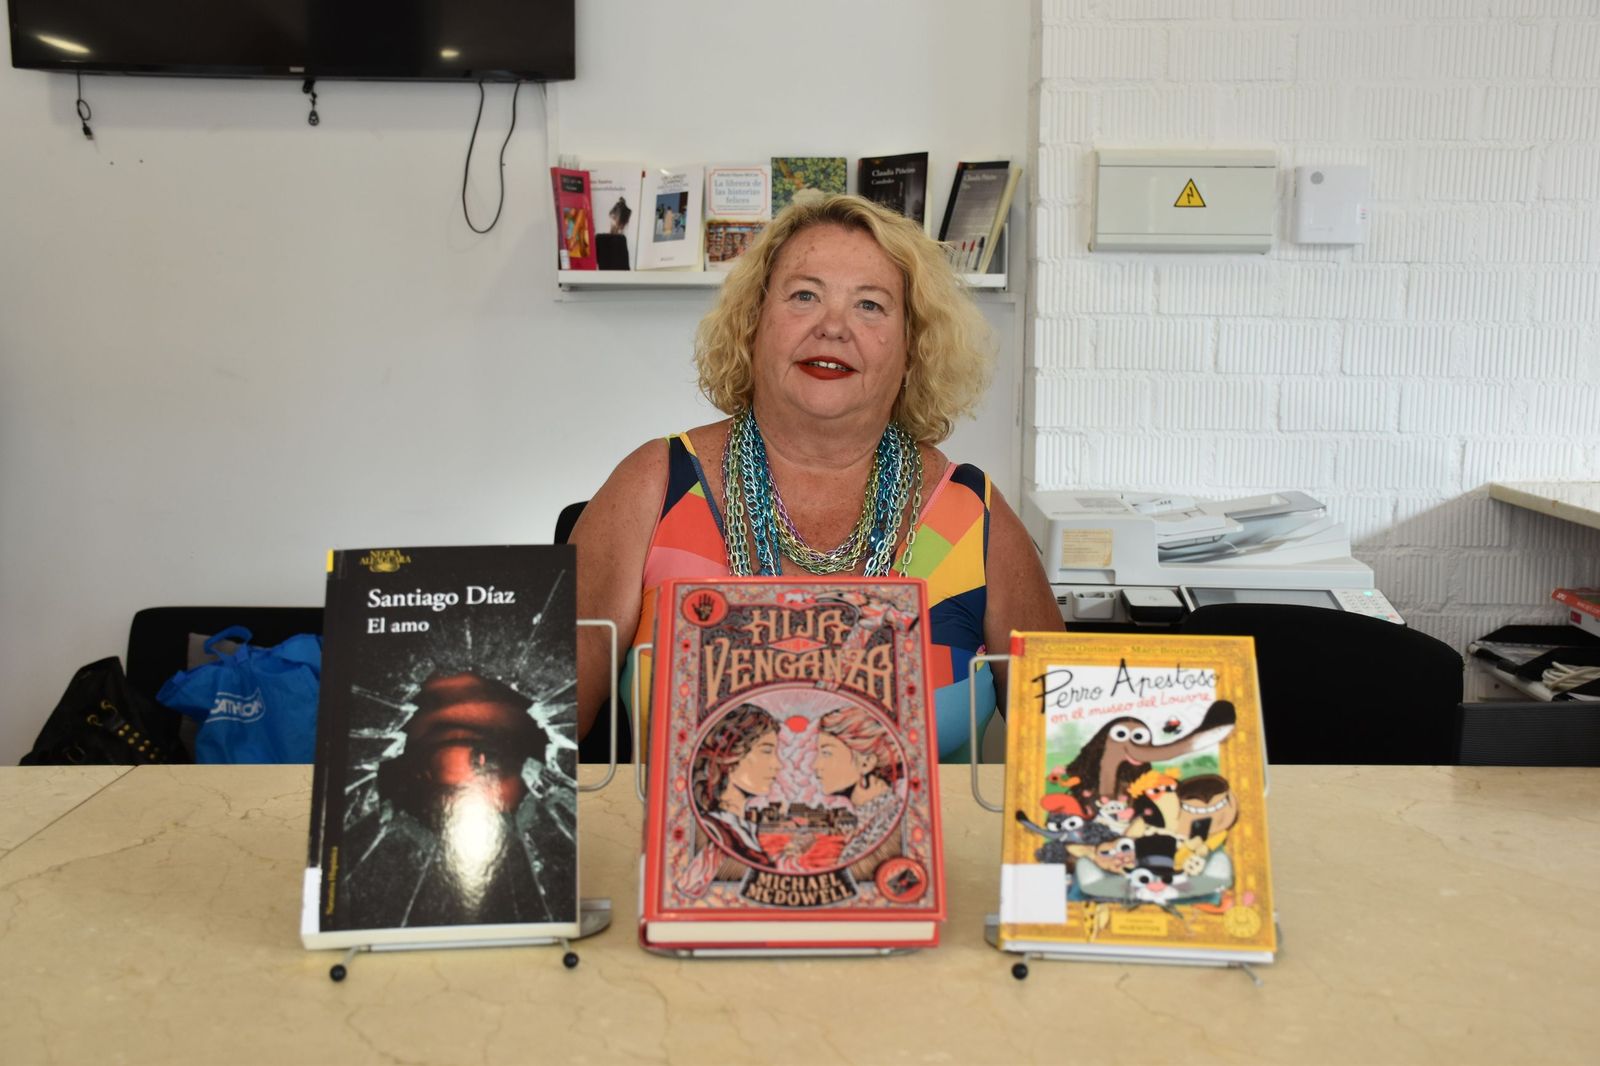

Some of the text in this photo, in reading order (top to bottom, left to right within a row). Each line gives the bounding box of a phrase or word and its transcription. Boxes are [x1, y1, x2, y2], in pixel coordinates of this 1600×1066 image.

[871, 168, 894, 177] Claudia
[369, 549, 401, 560] NEGRA
[367, 585, 516, 611] Santiago Díaz
[367, 617, 430, 634] El amo
[742, 608, 851, 645] HIJA
[703, 637, 894, 711] VENGANZA
[1031, 657, 1220, 714] Perro Apestoso
[1051, 690, 1213, 724] en el museo del Louvre
[756, 872, 841, 891] MICHAEL
